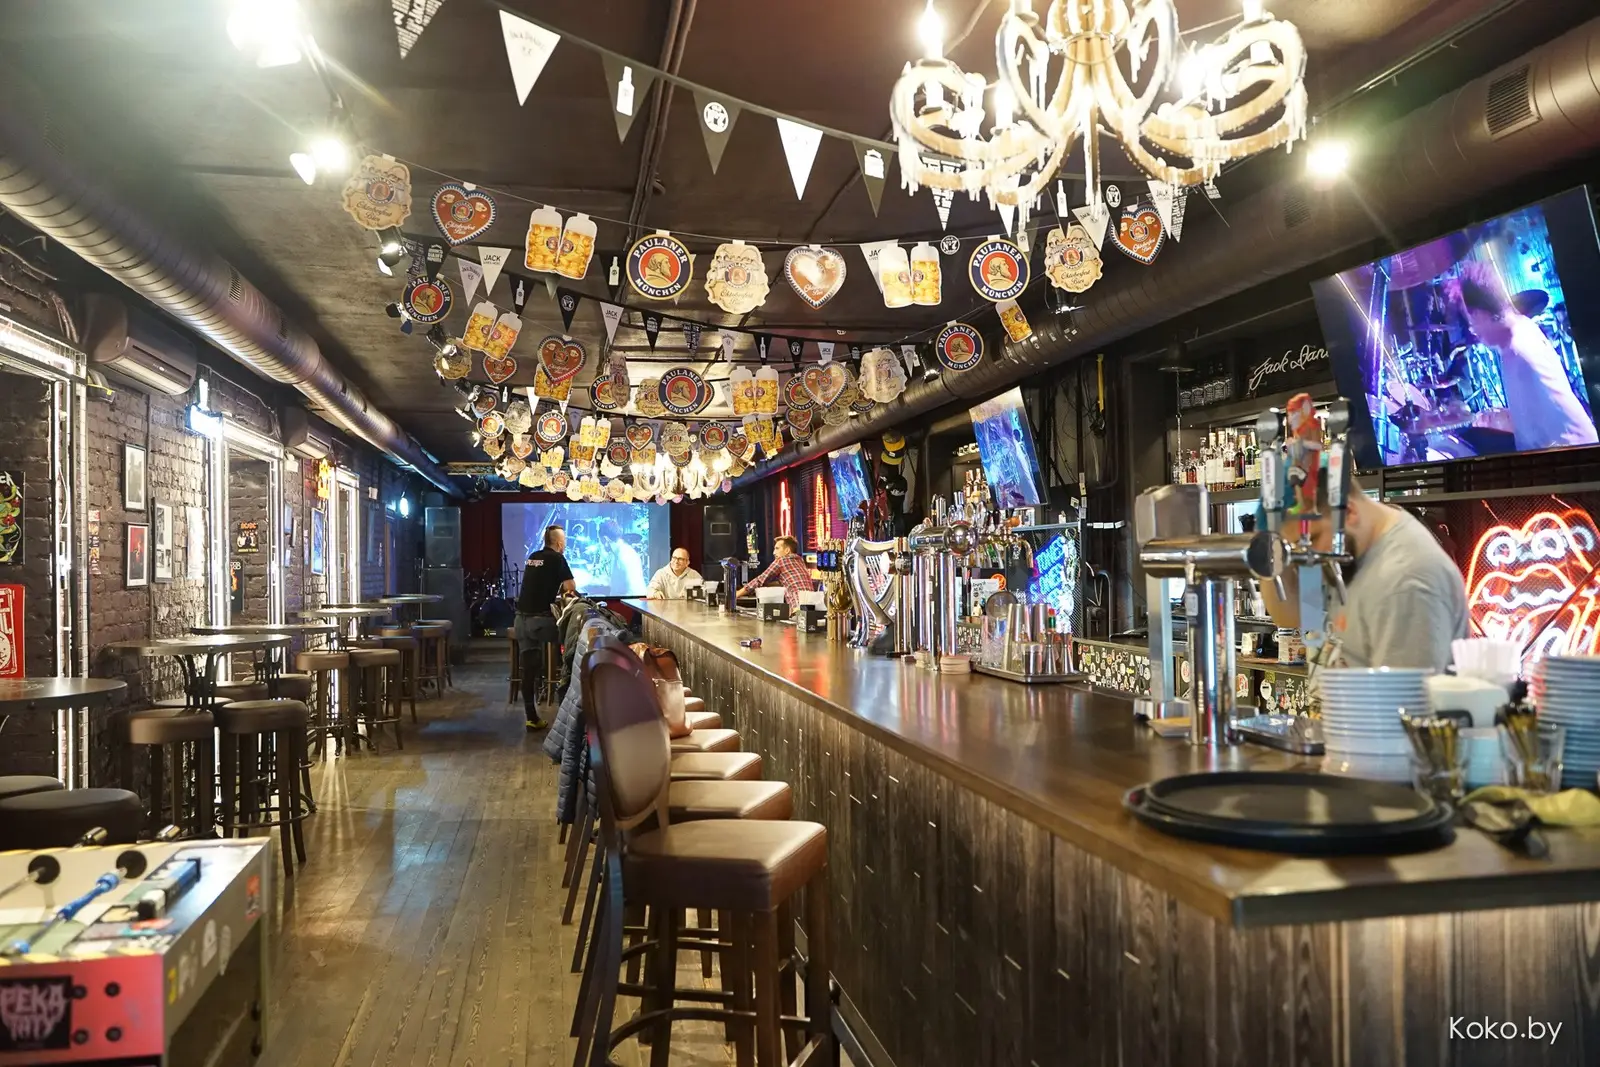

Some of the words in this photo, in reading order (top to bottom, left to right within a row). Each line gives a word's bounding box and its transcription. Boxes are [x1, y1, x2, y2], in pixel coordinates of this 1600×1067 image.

[484, 254, 501, 262] JACK
[633, 238, 689, 264] PAULANER
[973, 242, 1023, 268] PAULANER
[938, 326, 976, 348] PAULANER
[661, 369, 703, 388] PAULANER
[1249, 349, 1293, 391] Jack
